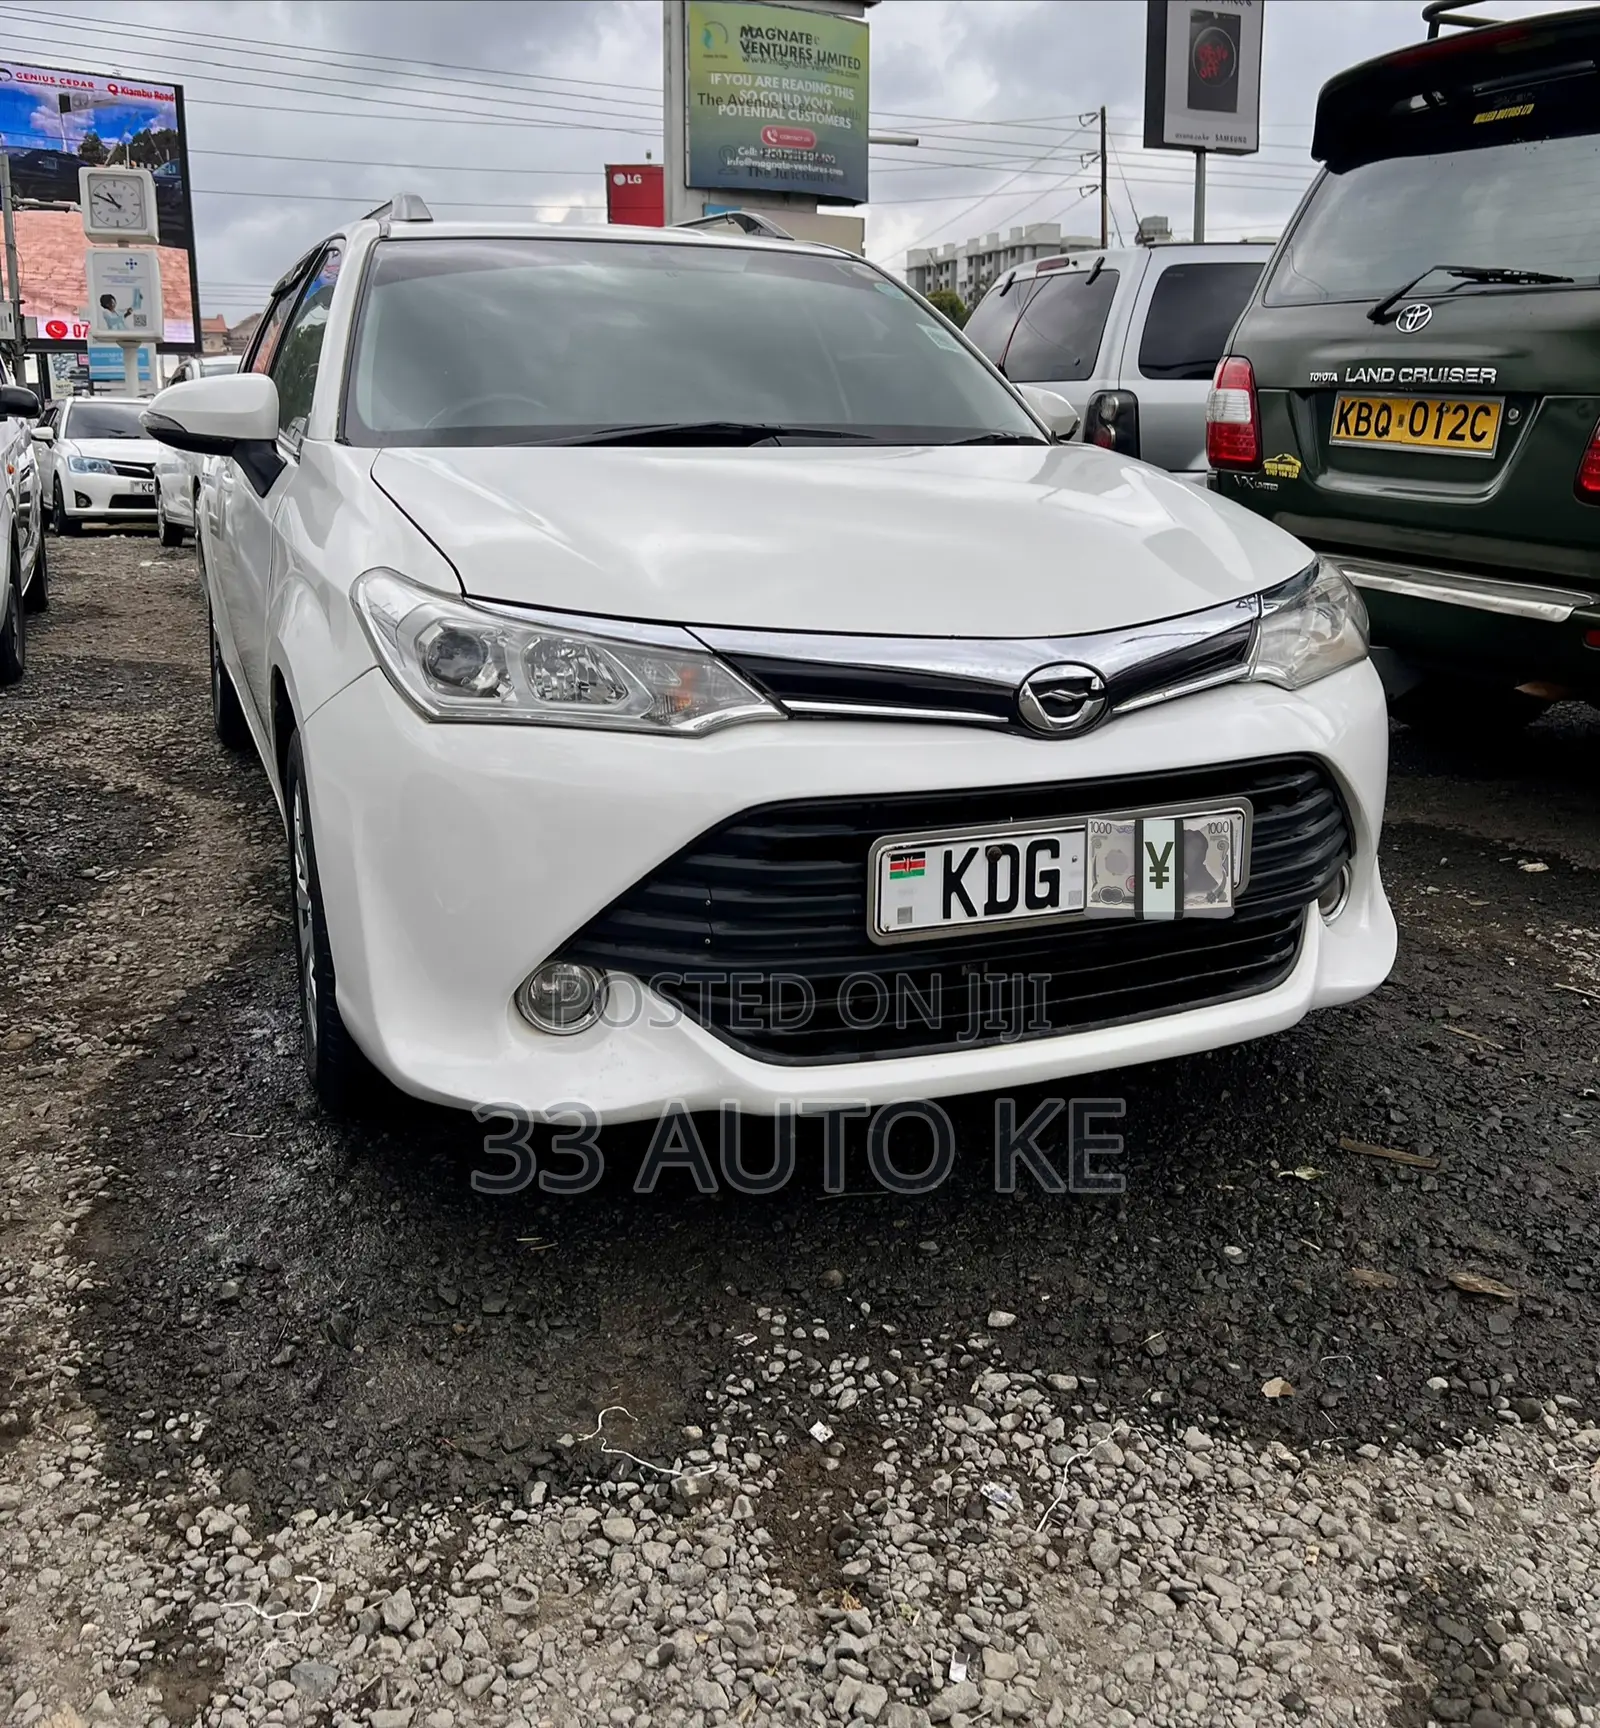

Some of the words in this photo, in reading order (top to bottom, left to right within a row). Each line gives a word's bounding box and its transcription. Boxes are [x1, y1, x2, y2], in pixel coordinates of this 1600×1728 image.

[740, 26, 812, 45] MAGNATE
[739, 40, 813, 60] VENTURES
[817, 50, 861, 70] LIMITED
[15, 71, 56, 84] GENIUS
[59, 77, 95, 89] CEDAR
[710, 73, 721, 85] IF
[724, 73, 752, 85] YOU
[755, 76, 780, 89] ARE
[782, 80, 832, 95] READING
[833, 87, 855, 100] THIS
[120, 86, 153, 98] Kiambu
[154, 92, 175, 102] Road
[697, 93, 724, 107] The
[739, 90, 758, 101] SO
[759, 91, 801, 106] COULD
[718, 104, 785, 120] POTENTIAL
[788, 110, 852, 129] CUSTOMERS
[1215, 133, 1247, 145] SAMSUNG
[627, 174, 642, 184] LG
[1310, 371, 1338, 382] TOYOTA
[1345, 368, 1395, 384] LAND
[1398, 367, 1497, 385] CRUISER
[1336, 401, 1393, 439] KBQ
[1408, 401, 1492, 443] 012C
[942, 838, 1061, 920] KDG
